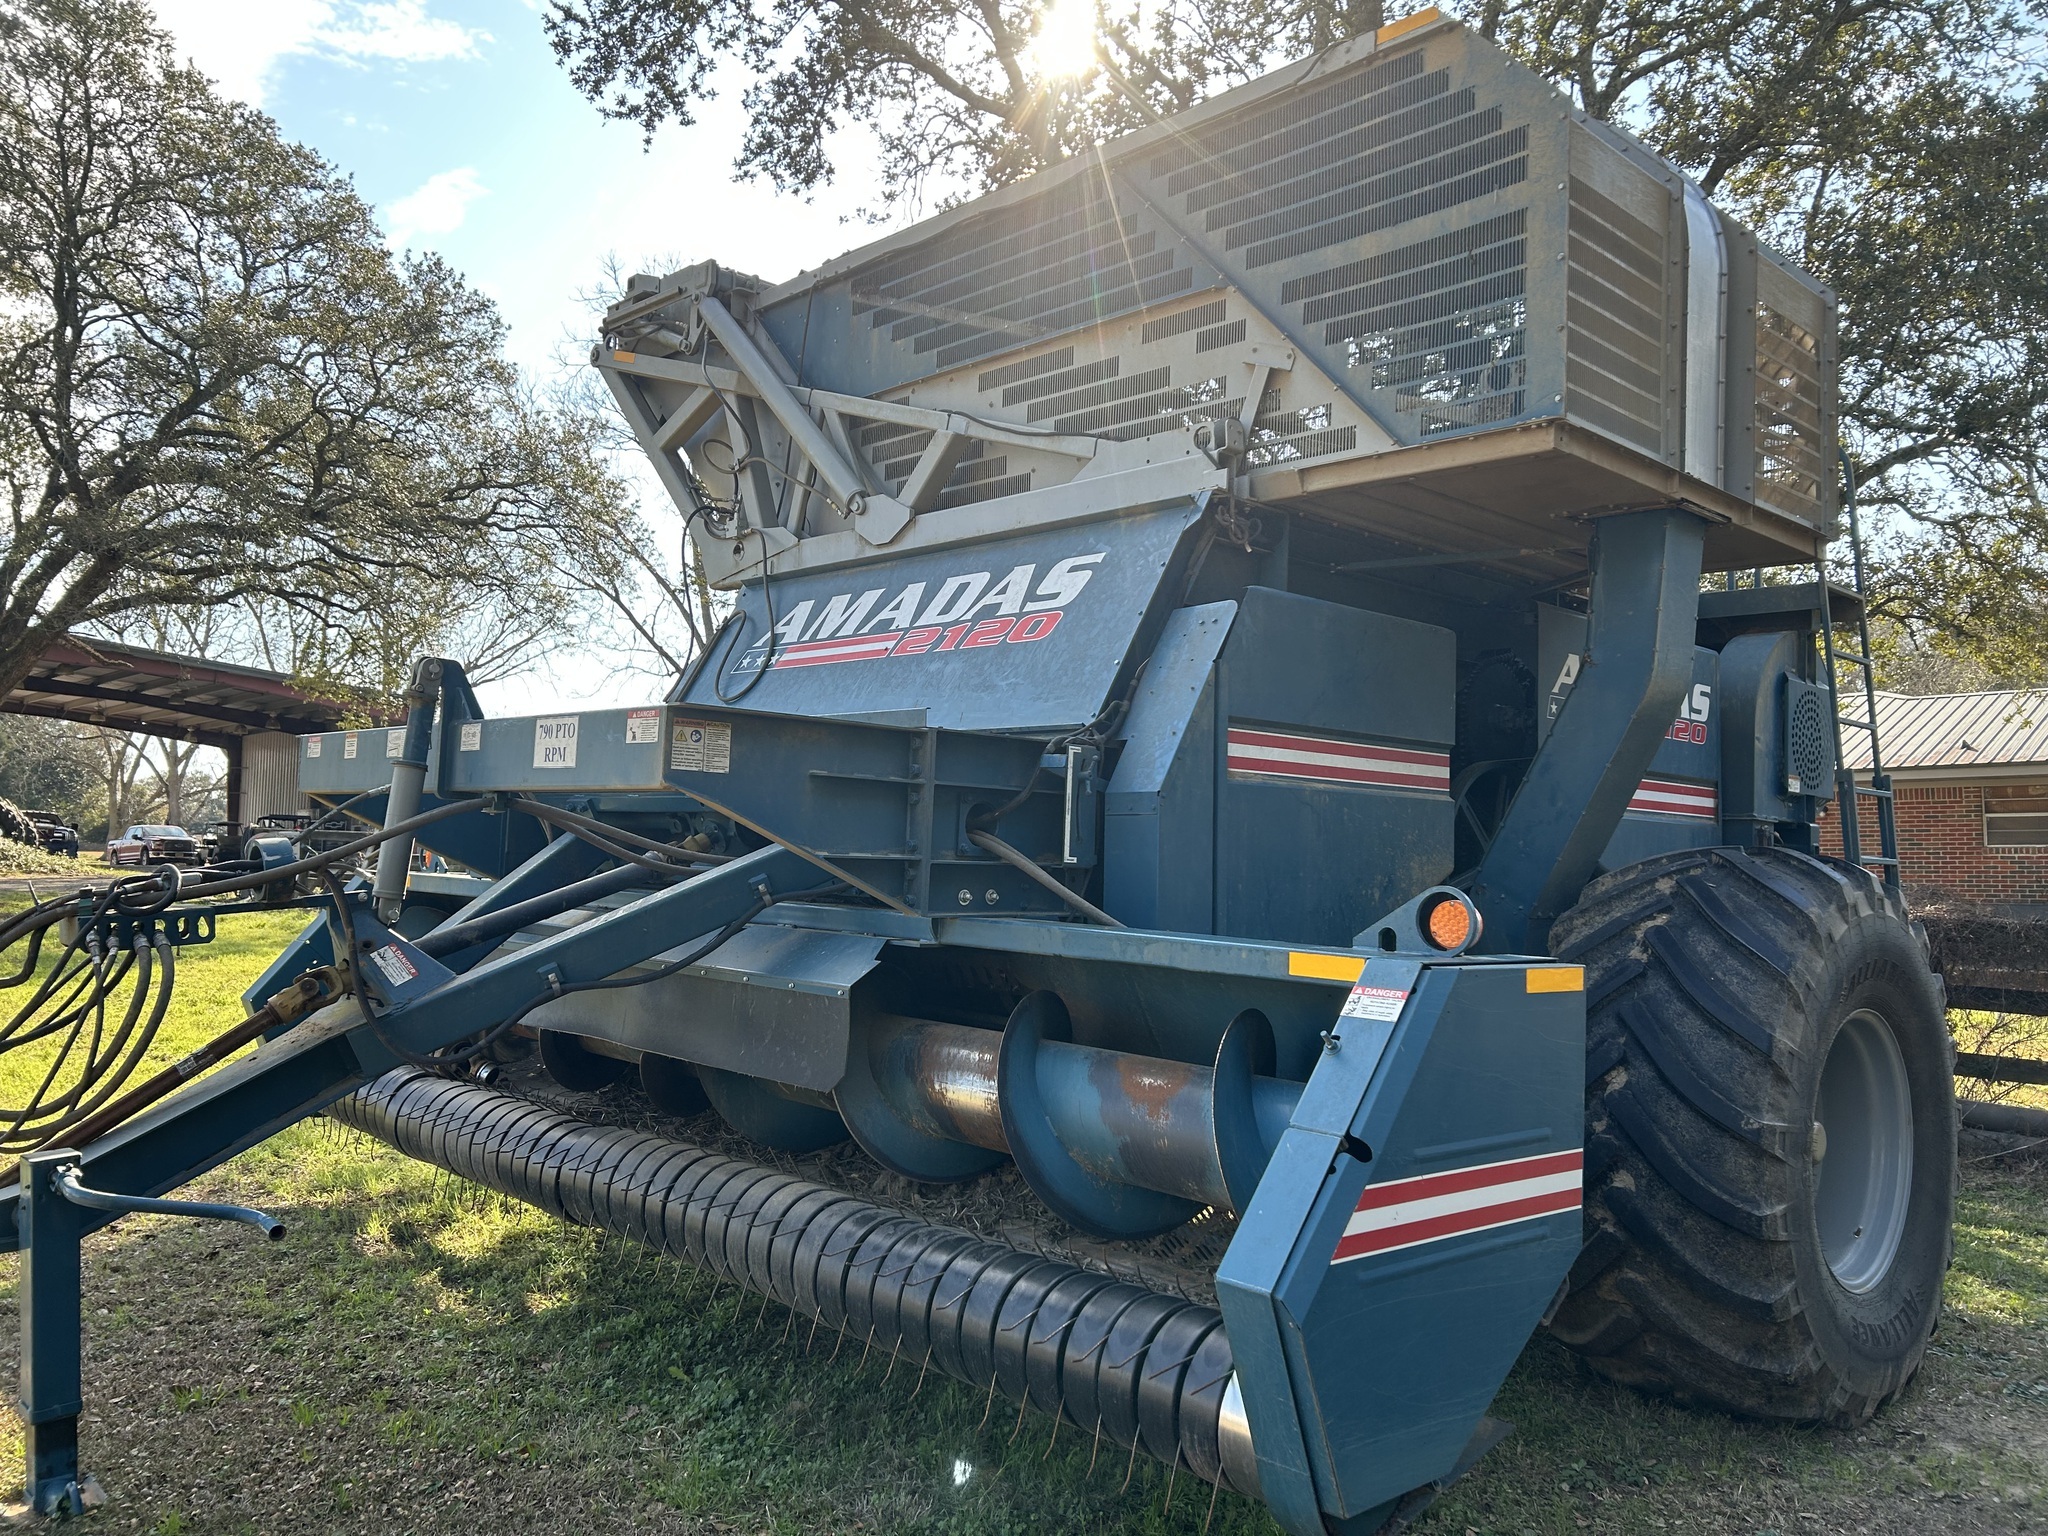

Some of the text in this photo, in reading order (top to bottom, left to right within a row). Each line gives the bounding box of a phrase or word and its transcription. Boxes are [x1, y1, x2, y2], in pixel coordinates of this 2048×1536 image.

[753, 552, 1107, 647] AMADAS
[889, 611, 1064, 657] 2120
[637, 710, 656, 718] DANGER
[538, 723, 576, 740] 790 PTO
[544, 747, 567, 763] RPM
[395, 951, 417, 974] DANGER
[1364, 988, 1403, 998] DANGER
